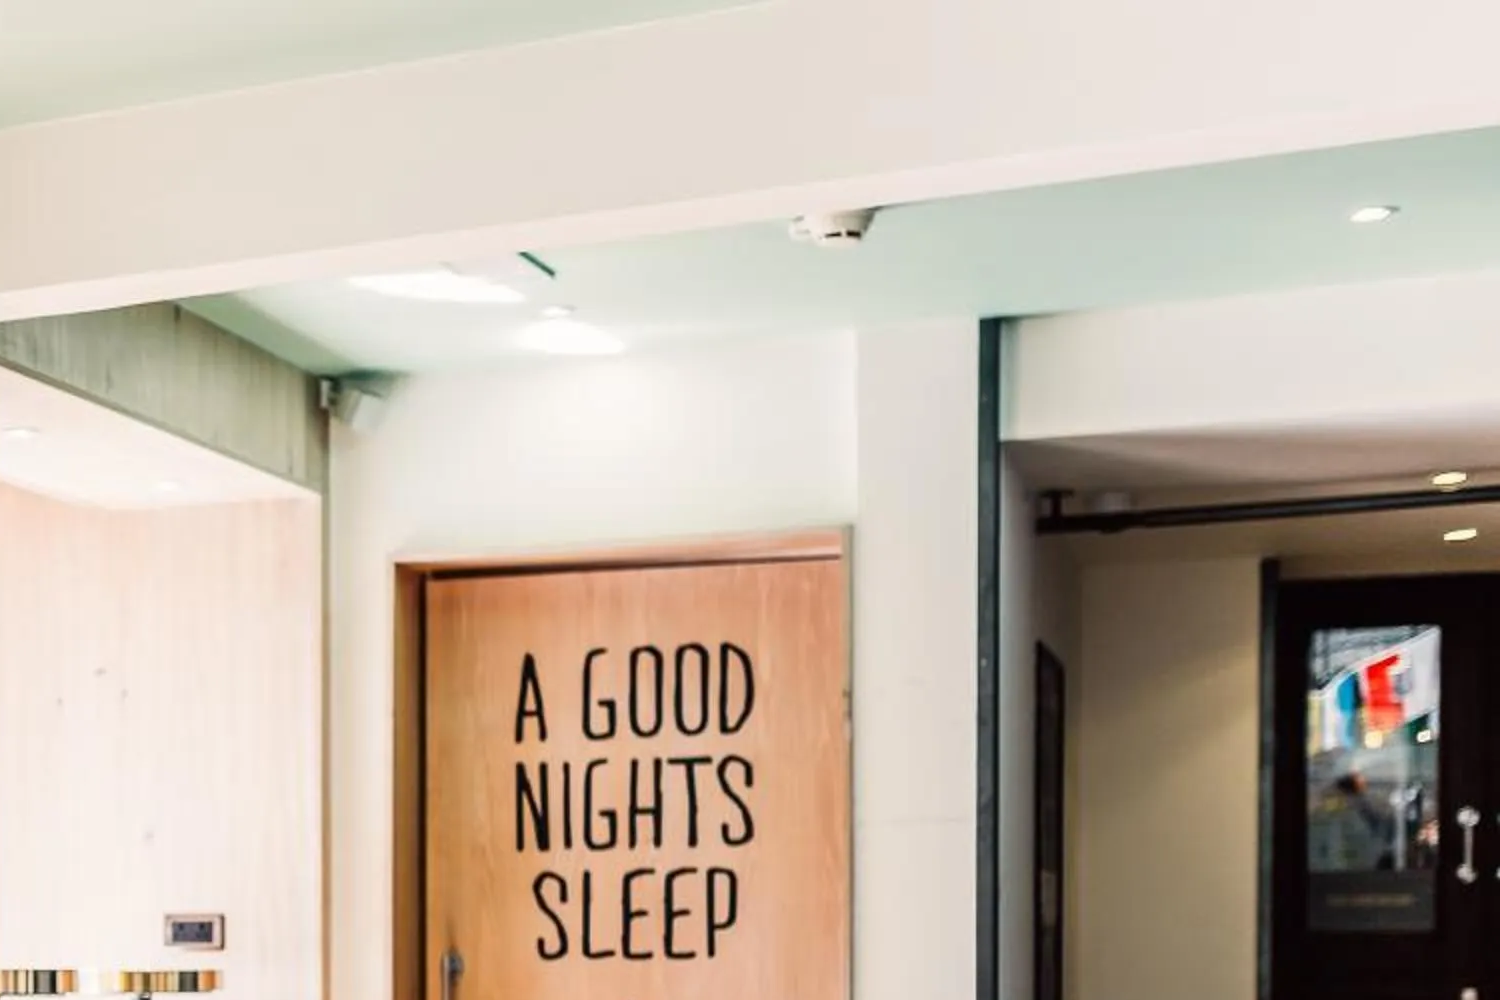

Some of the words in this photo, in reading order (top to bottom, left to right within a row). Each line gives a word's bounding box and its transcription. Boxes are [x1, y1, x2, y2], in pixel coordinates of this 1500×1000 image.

[515, 653, 547, 744] A
[582, 642, 754, 740] GOOD
[516, 755, 754, 852] NIGHTS
[532, 867, 737, 960] SLEEP
